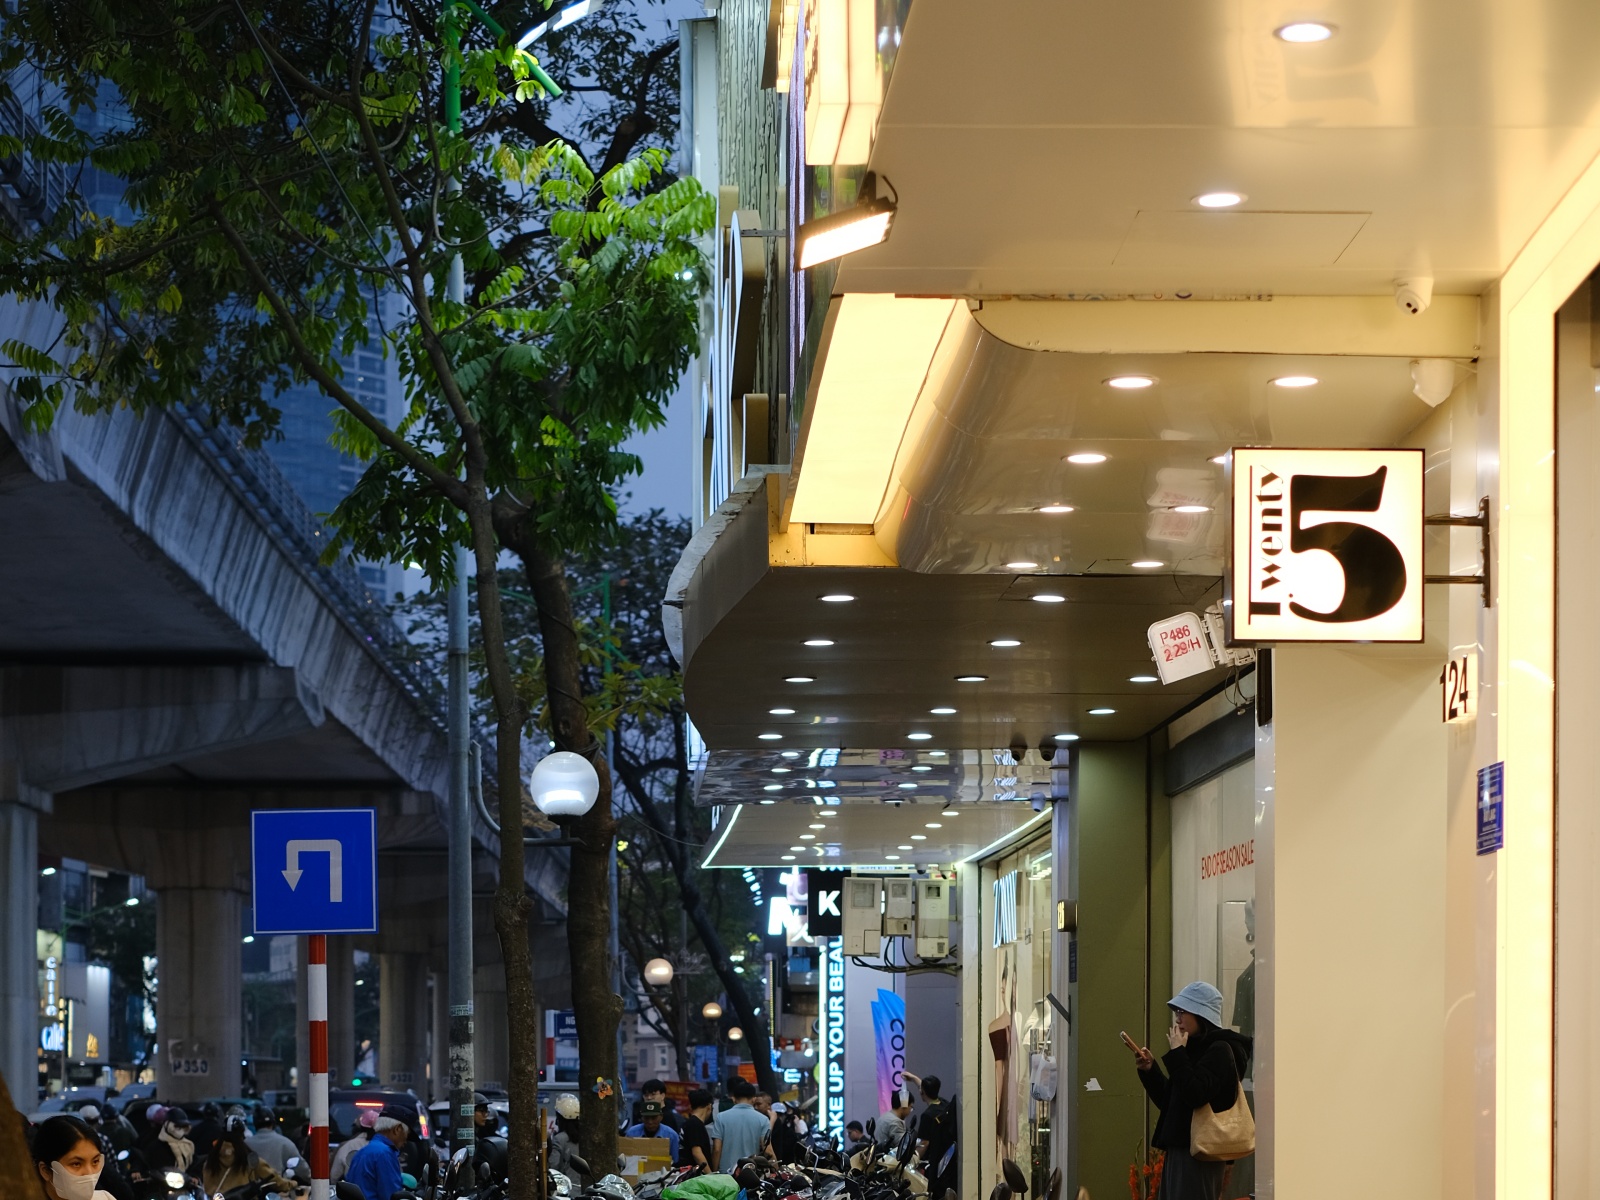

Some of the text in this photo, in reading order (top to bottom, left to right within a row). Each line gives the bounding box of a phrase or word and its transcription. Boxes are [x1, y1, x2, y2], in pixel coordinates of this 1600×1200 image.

[1248, 465, 1284, 625] Twenty
[1289, 465, 1407, 623] 5
[1160, 625, 1191, 645] P486
[1440, 654, 1469, 723] 124
[1241, 839, 1254, 867] SALE
[565, 1016, 576, 1025] NG
[829, 996, 844, 1059] YOUR
[829, 1062, 844, 1093] UP
[890, 1018, 905, 1092] COCO
